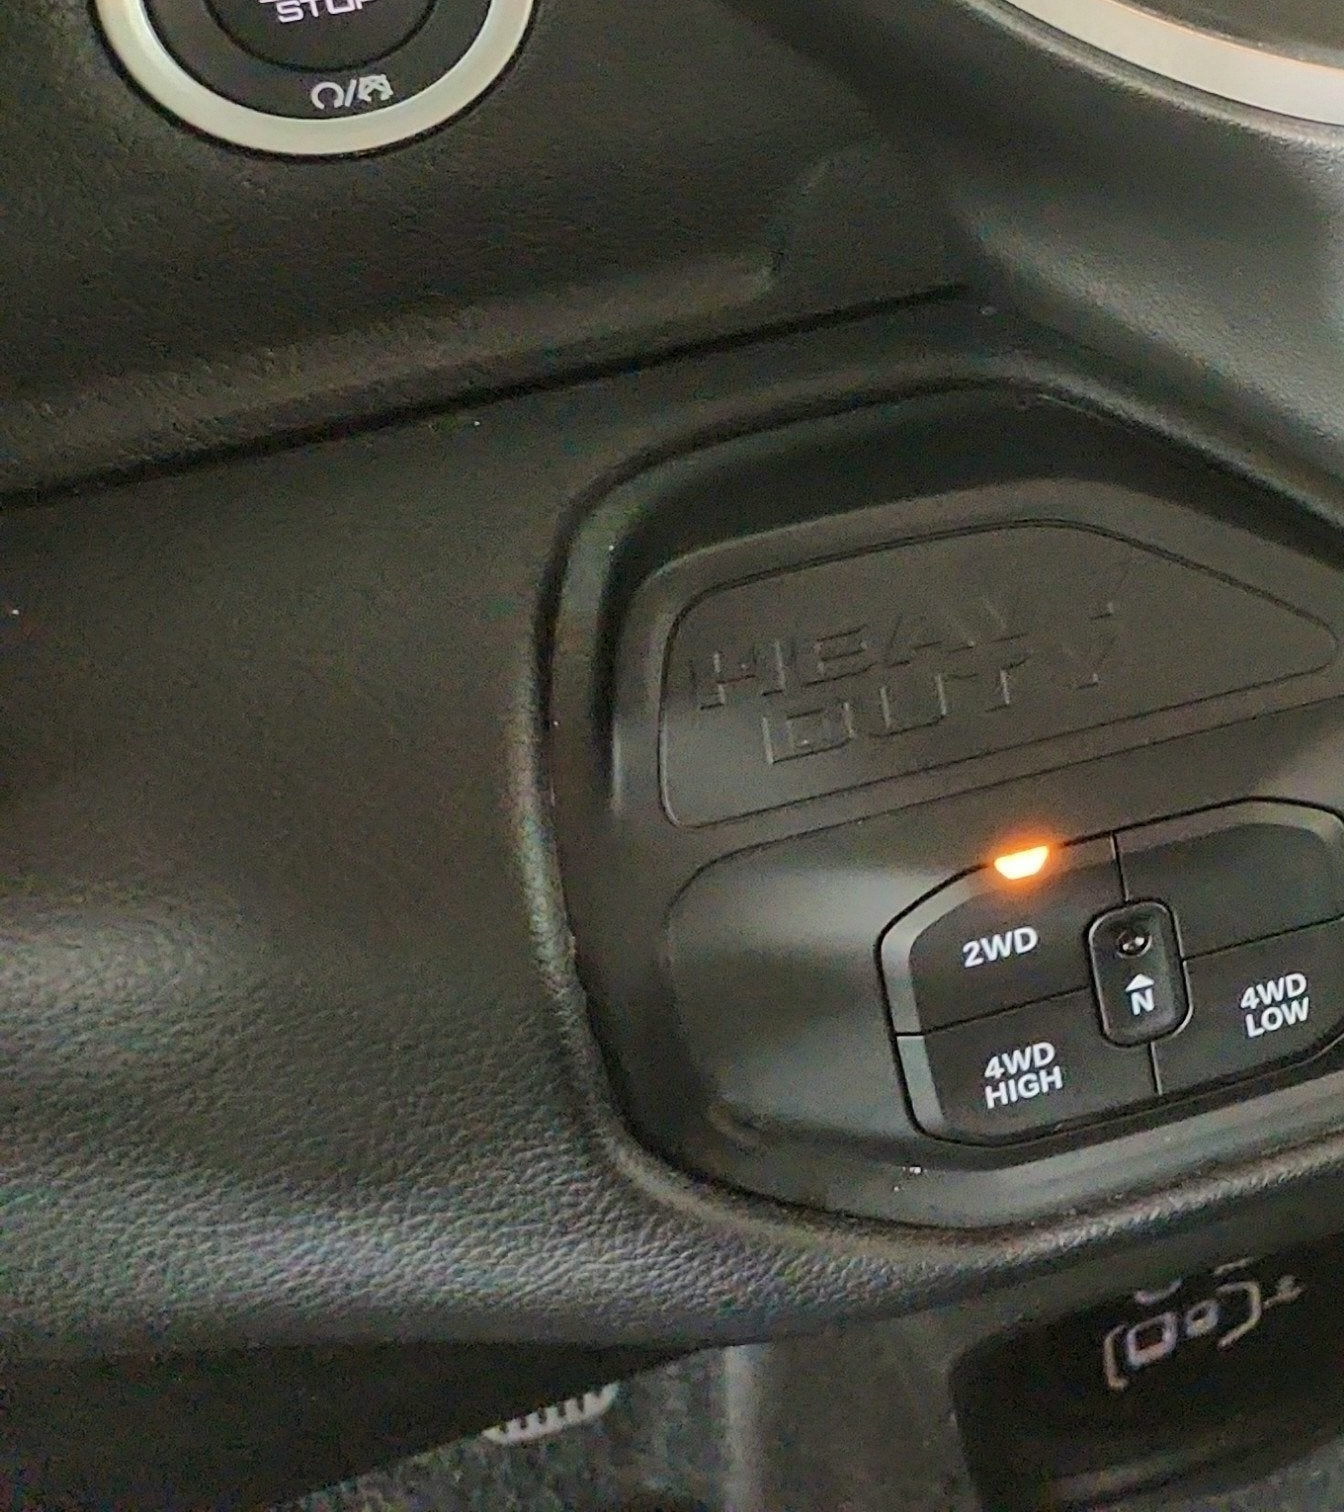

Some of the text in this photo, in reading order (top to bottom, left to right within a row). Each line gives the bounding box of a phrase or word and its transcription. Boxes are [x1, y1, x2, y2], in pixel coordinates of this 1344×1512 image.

[962, 925, 1039, 969] 2WD
[1130, 988, 1156, 1016] N
[1239, 971, 1308, 1011] 4WD
[1244, 996, 1310, 1039] LOW
[983, 1040, 1057, 1081] 4WD
[984, 1064, 1064, 1110] HIGH
